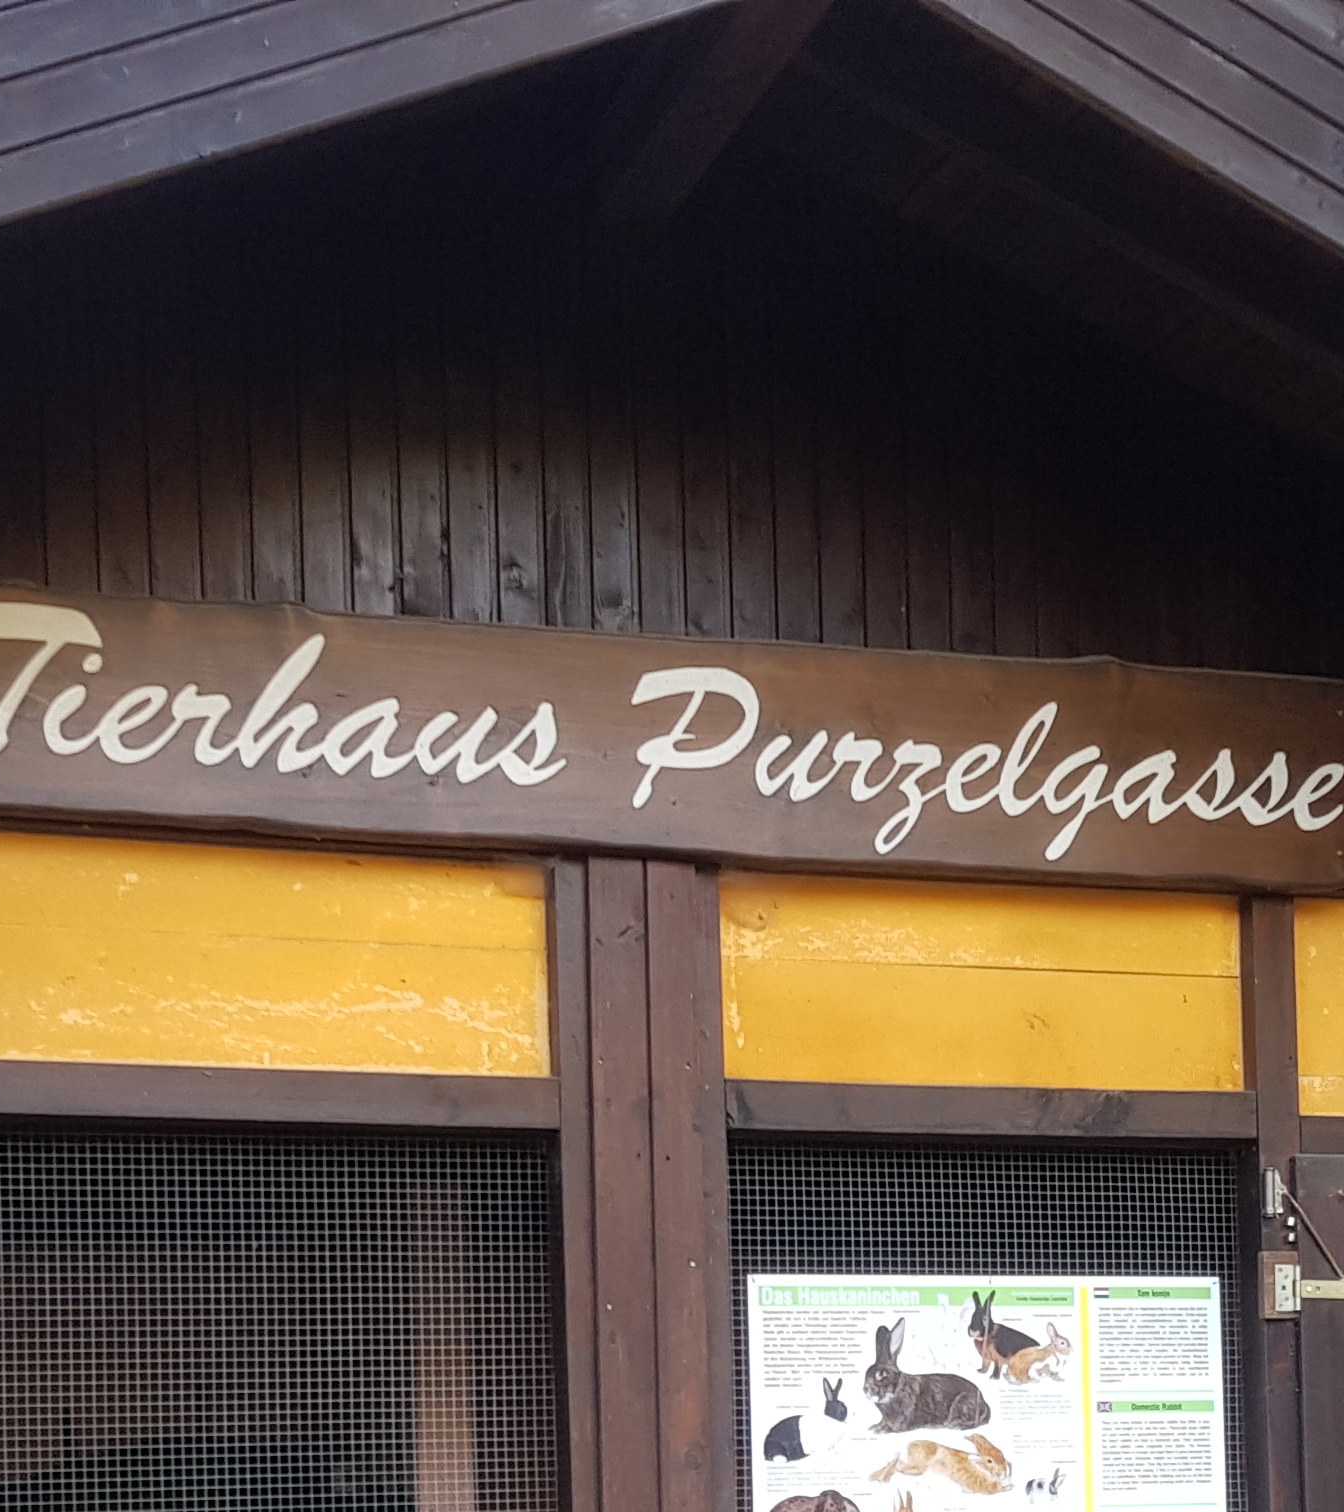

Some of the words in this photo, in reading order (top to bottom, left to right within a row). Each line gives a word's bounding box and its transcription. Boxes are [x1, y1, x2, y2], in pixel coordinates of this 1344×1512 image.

[761, 1287, 793, 1305] Das
[797, 1287, 920, 1305] Hauskaninchen
[1131, 1403, 1160, 1411] Domestic
[1162, 1403, 1182, 1411] Rabbit
